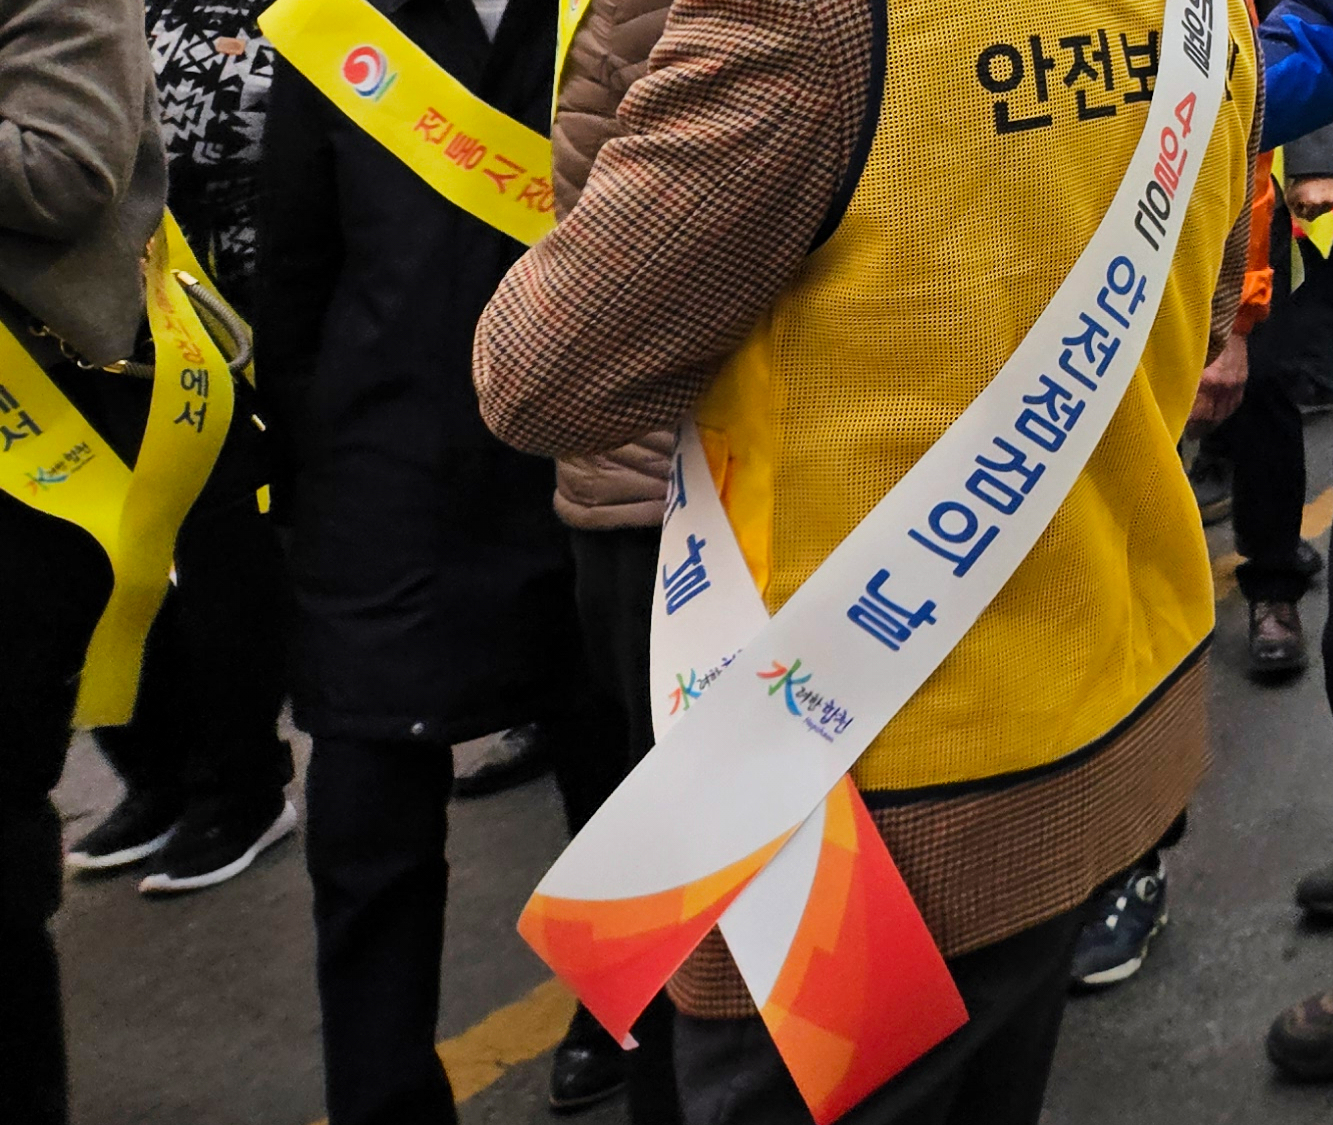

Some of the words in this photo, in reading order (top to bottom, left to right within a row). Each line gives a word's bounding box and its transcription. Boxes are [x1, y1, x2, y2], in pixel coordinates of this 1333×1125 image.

[1134, 91, 1198, 252] 4일은
[907, 255, 1147, 577] 안전점검의
[663, 533, 711, 615] 날
[846, 568, 937, 652] 날
